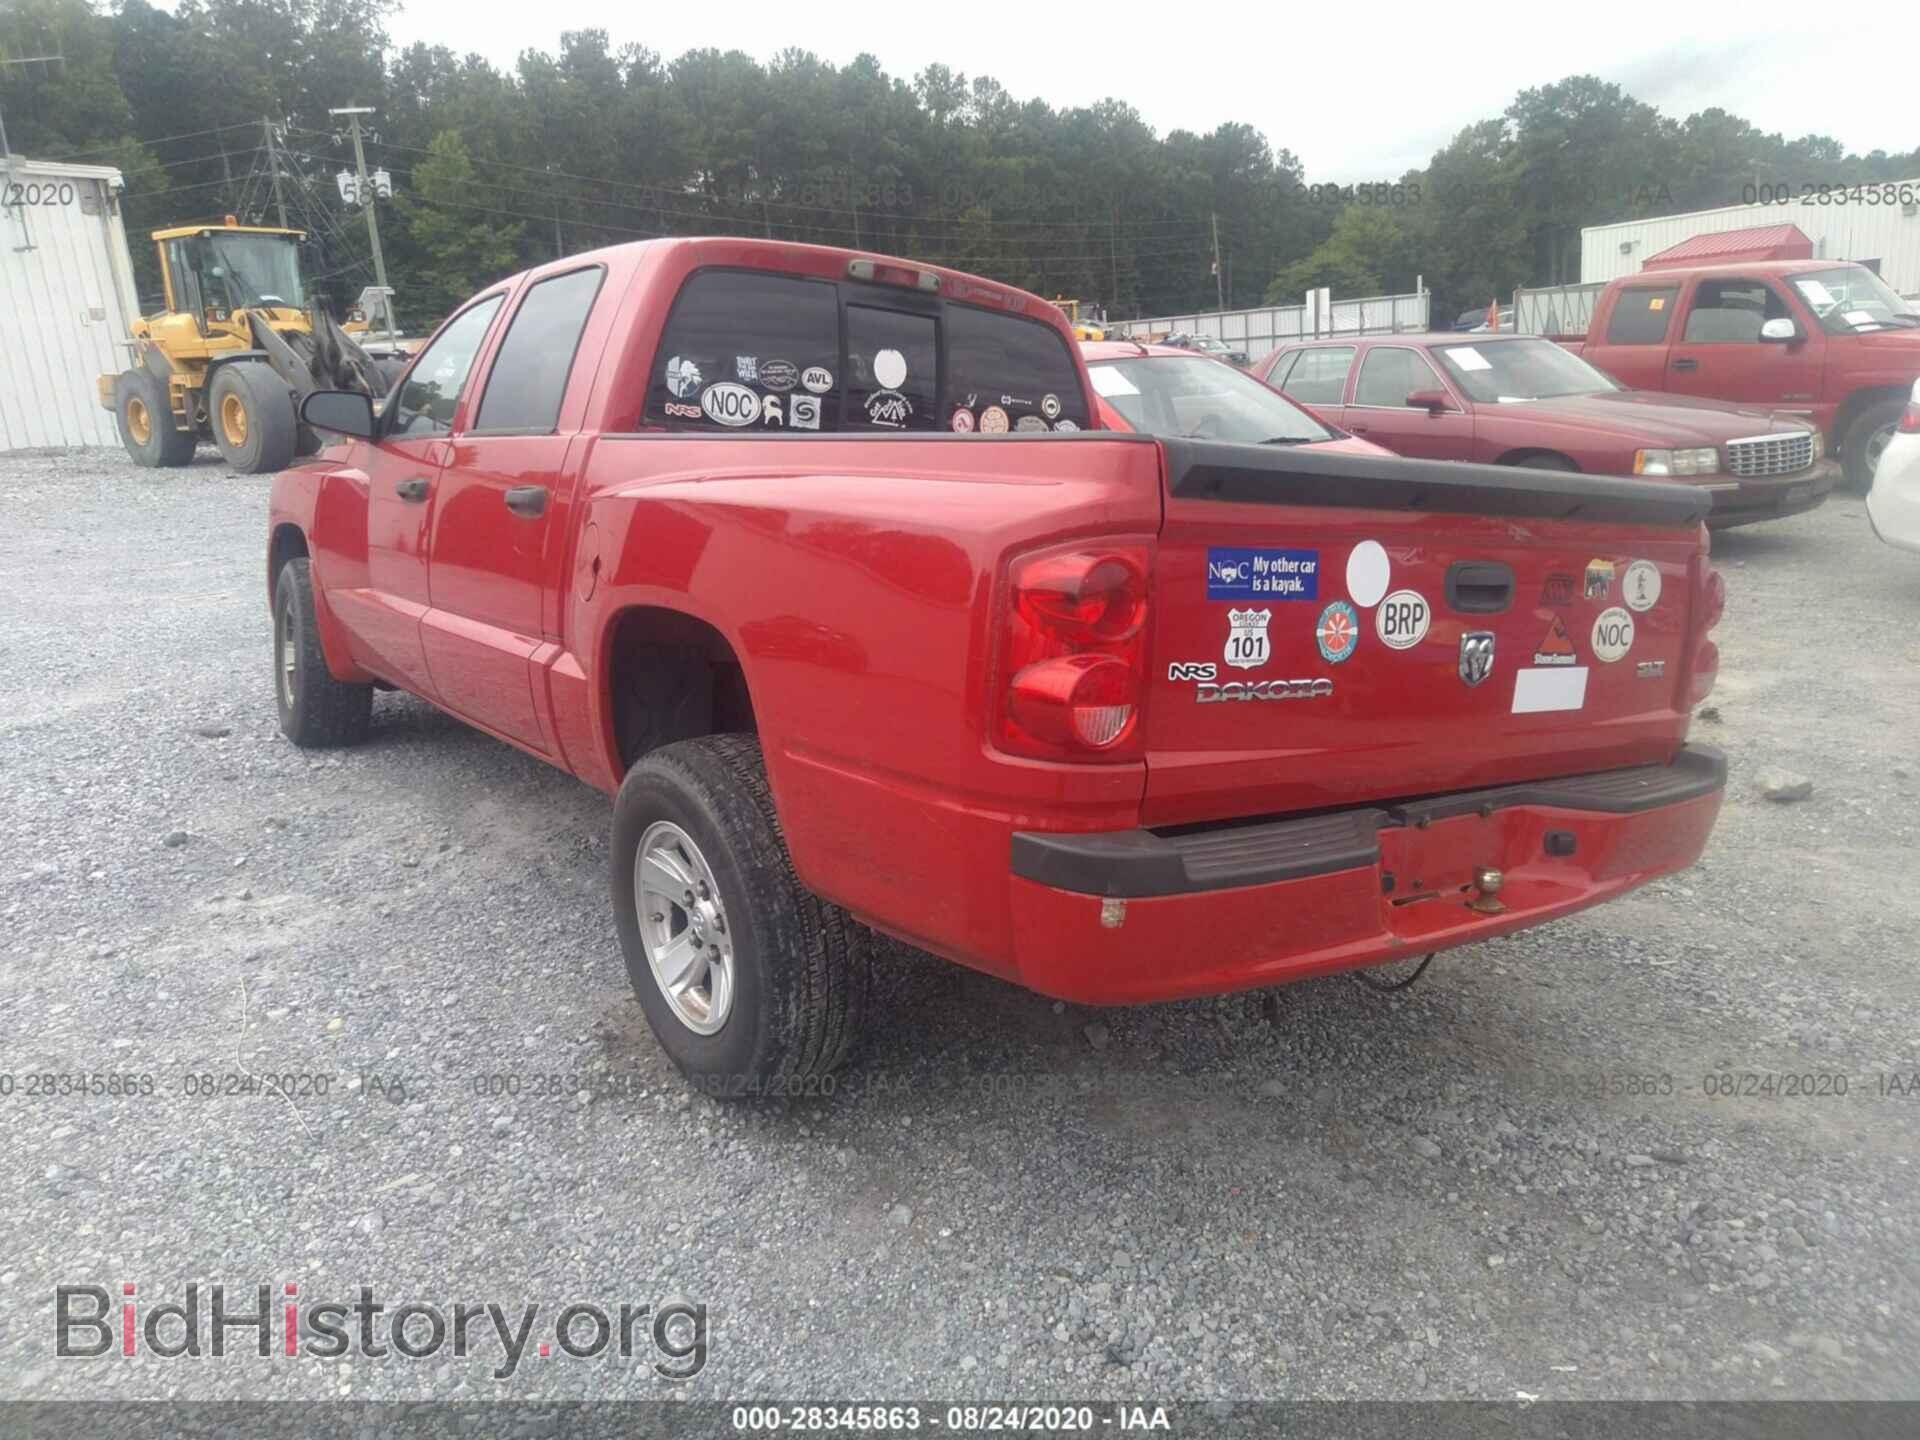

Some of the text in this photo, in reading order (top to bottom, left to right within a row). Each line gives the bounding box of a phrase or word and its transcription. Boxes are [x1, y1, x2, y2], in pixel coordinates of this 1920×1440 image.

[807, 372, 829, 386] AVL
[711, 389, 752, 419] NOC
[1253, 556, 1316, 576] My other car
[1252, 576, 1305, 595] is a kayak.
[1232, 613, 1268, 622] OREGON
[1384, 603, 1425, 636] BRP
[1597, 623, 1631, 647] NOC
[1232, 636, 1264, 659] 101
[1169, 664, 1216, 680] NRS
[1196, 678, 1333, 703] DAKOTA
